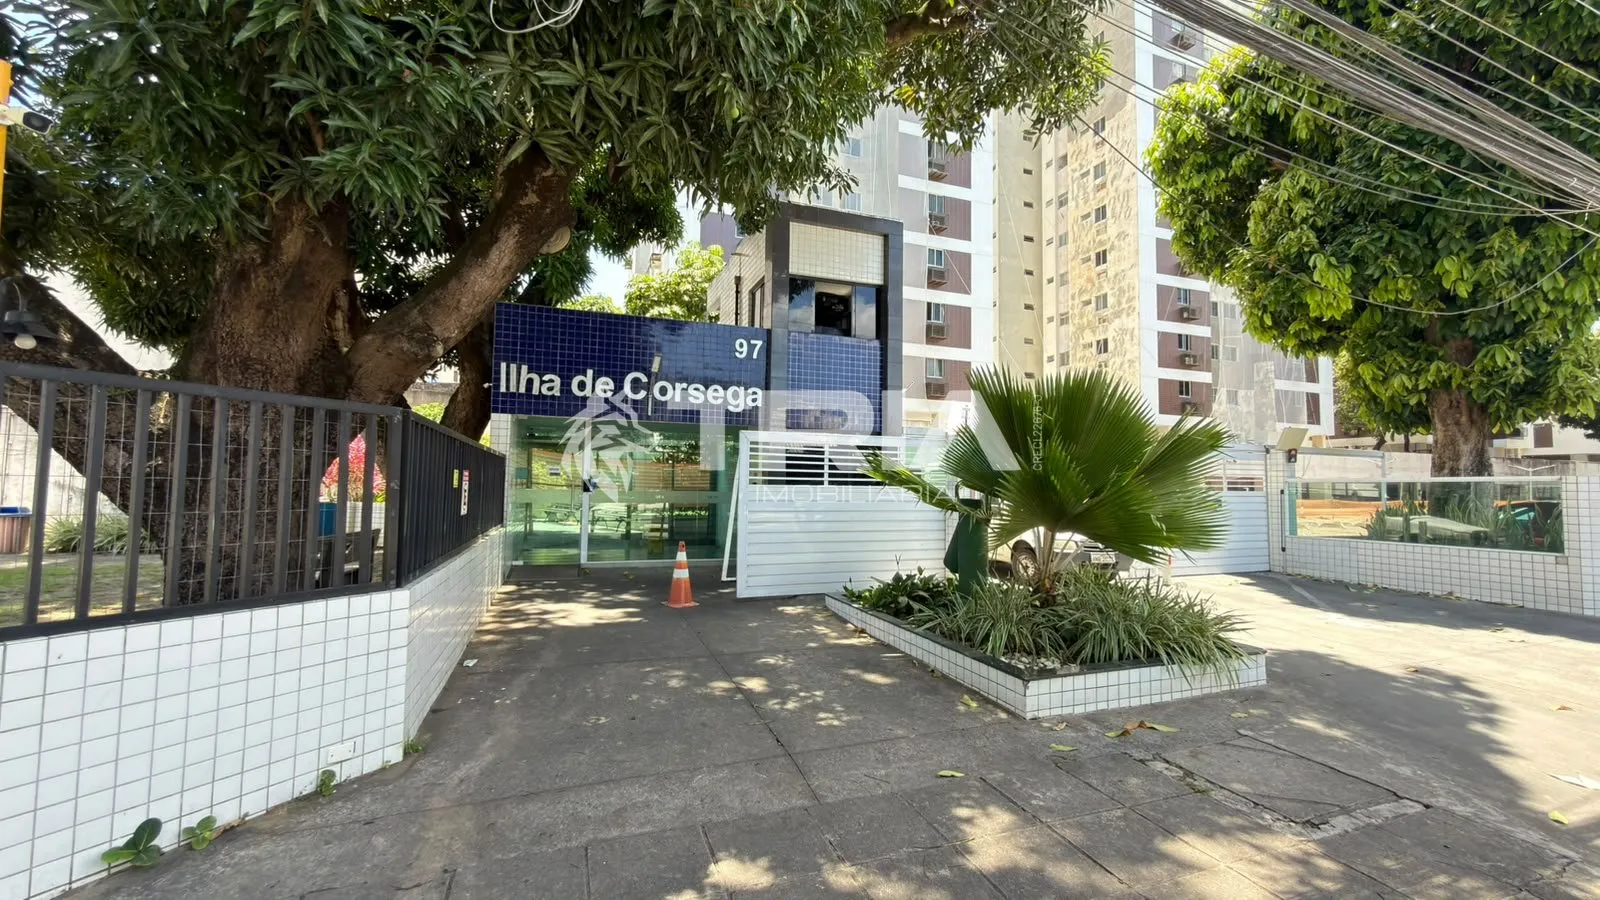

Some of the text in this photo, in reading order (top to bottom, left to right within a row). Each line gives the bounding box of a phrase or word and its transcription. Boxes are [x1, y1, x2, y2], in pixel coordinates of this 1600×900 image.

[735, 338, 763, 360] 97
[500, 361, 763, 413] Ilha de Corsega
